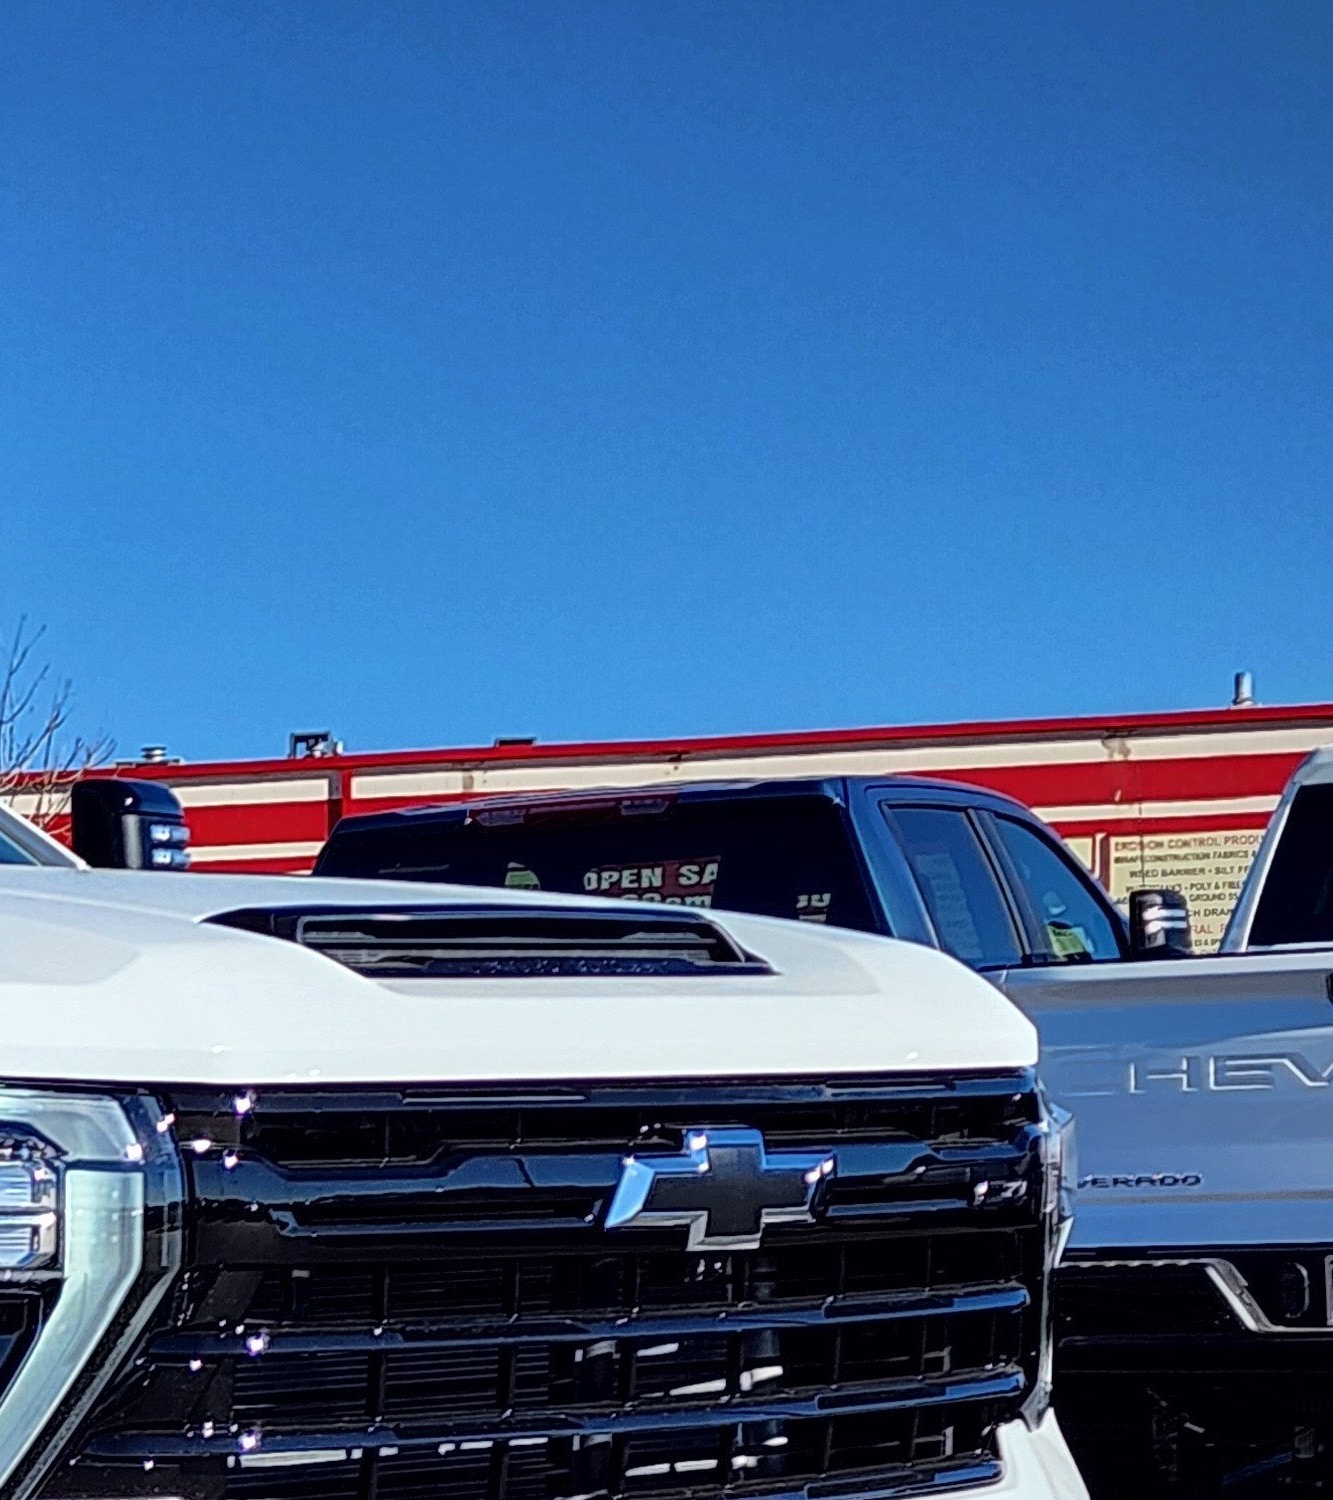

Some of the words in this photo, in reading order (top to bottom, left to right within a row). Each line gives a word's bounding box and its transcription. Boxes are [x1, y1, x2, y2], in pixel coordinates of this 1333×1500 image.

[1168, 836, 1221, 849] CONTROL
[1161, 866, 1206, 877] BARRIER
[1214, 865, 1235, 875] SILT
[583, 867, 664, 891] OPEN
[1189, 882, 1212, 891] POLY
